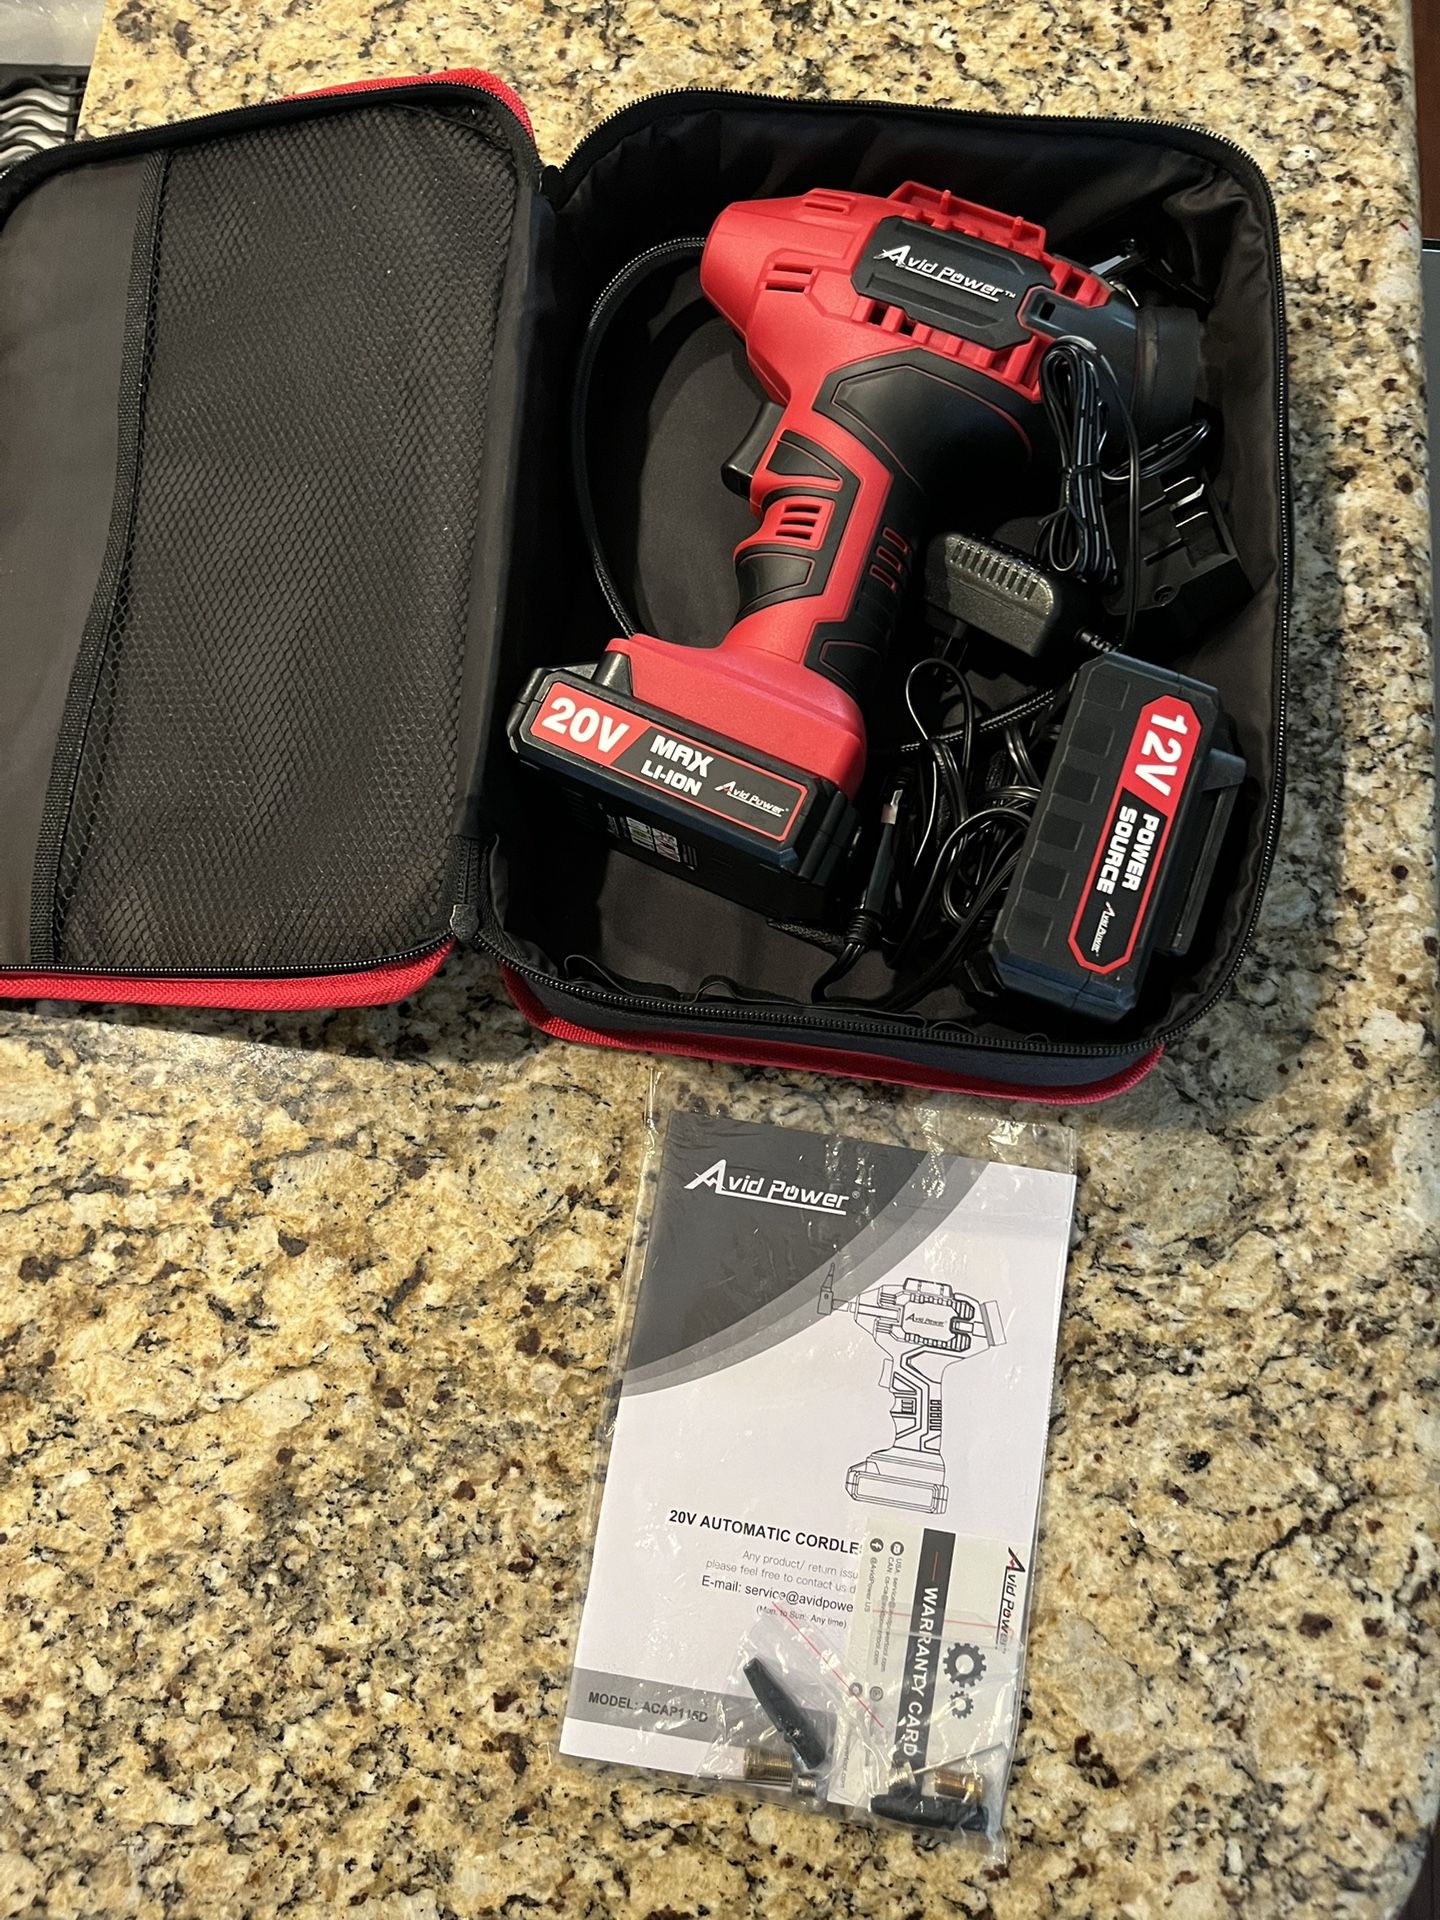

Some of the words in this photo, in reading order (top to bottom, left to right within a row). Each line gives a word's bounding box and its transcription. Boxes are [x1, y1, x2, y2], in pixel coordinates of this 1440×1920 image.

[873, 245, 938, 274] Avid
[541, 697, 630, 753] 20V
[649, 734, 714, 778] MAX
[1134, 713, 1188, 797] 12V
[640, 759, 703, 796] LI-ION
[714, 781, 750, 803] Avid
[1096, 805, 1138, 895] SOURCE
[1121, 812, 1160, 891] POWER
[684, 1158, 765, 1196] Avid
[668, 1509, 697, 1525] 20V
[699, 1515, 791, 1543] AUTOMATIC
[795, 1532, 863, 1555] CORDLE
[705, 1558, 737, 1573] please
[740, 1564, 758, 1575] feel
[761, 1568, 780, 1580] free
[784, 1572, 793, 1582] to
[796, 1576, 832, 1590] contact
[835, 1583, 847, 1592] us
[849, 1584, 856, 1594] d
[742, 1550, 760, 1563] Any
[807, 1563, 837, 1575] return
[839, 1569, 858, 1580] issu
[1005, 1546, 1026, 1596] Avid
[701, 1575, 742, 1593] E-mail:
[744, 1584, 854, 1613] service@avidpowe
[810, 1614, 826, 1625] Any
[914, 1587, 939, 1698] WARRANTY
[588, 1691, 638, 1710] MODEL:
[904, 1701, 924, 1757] CARD
